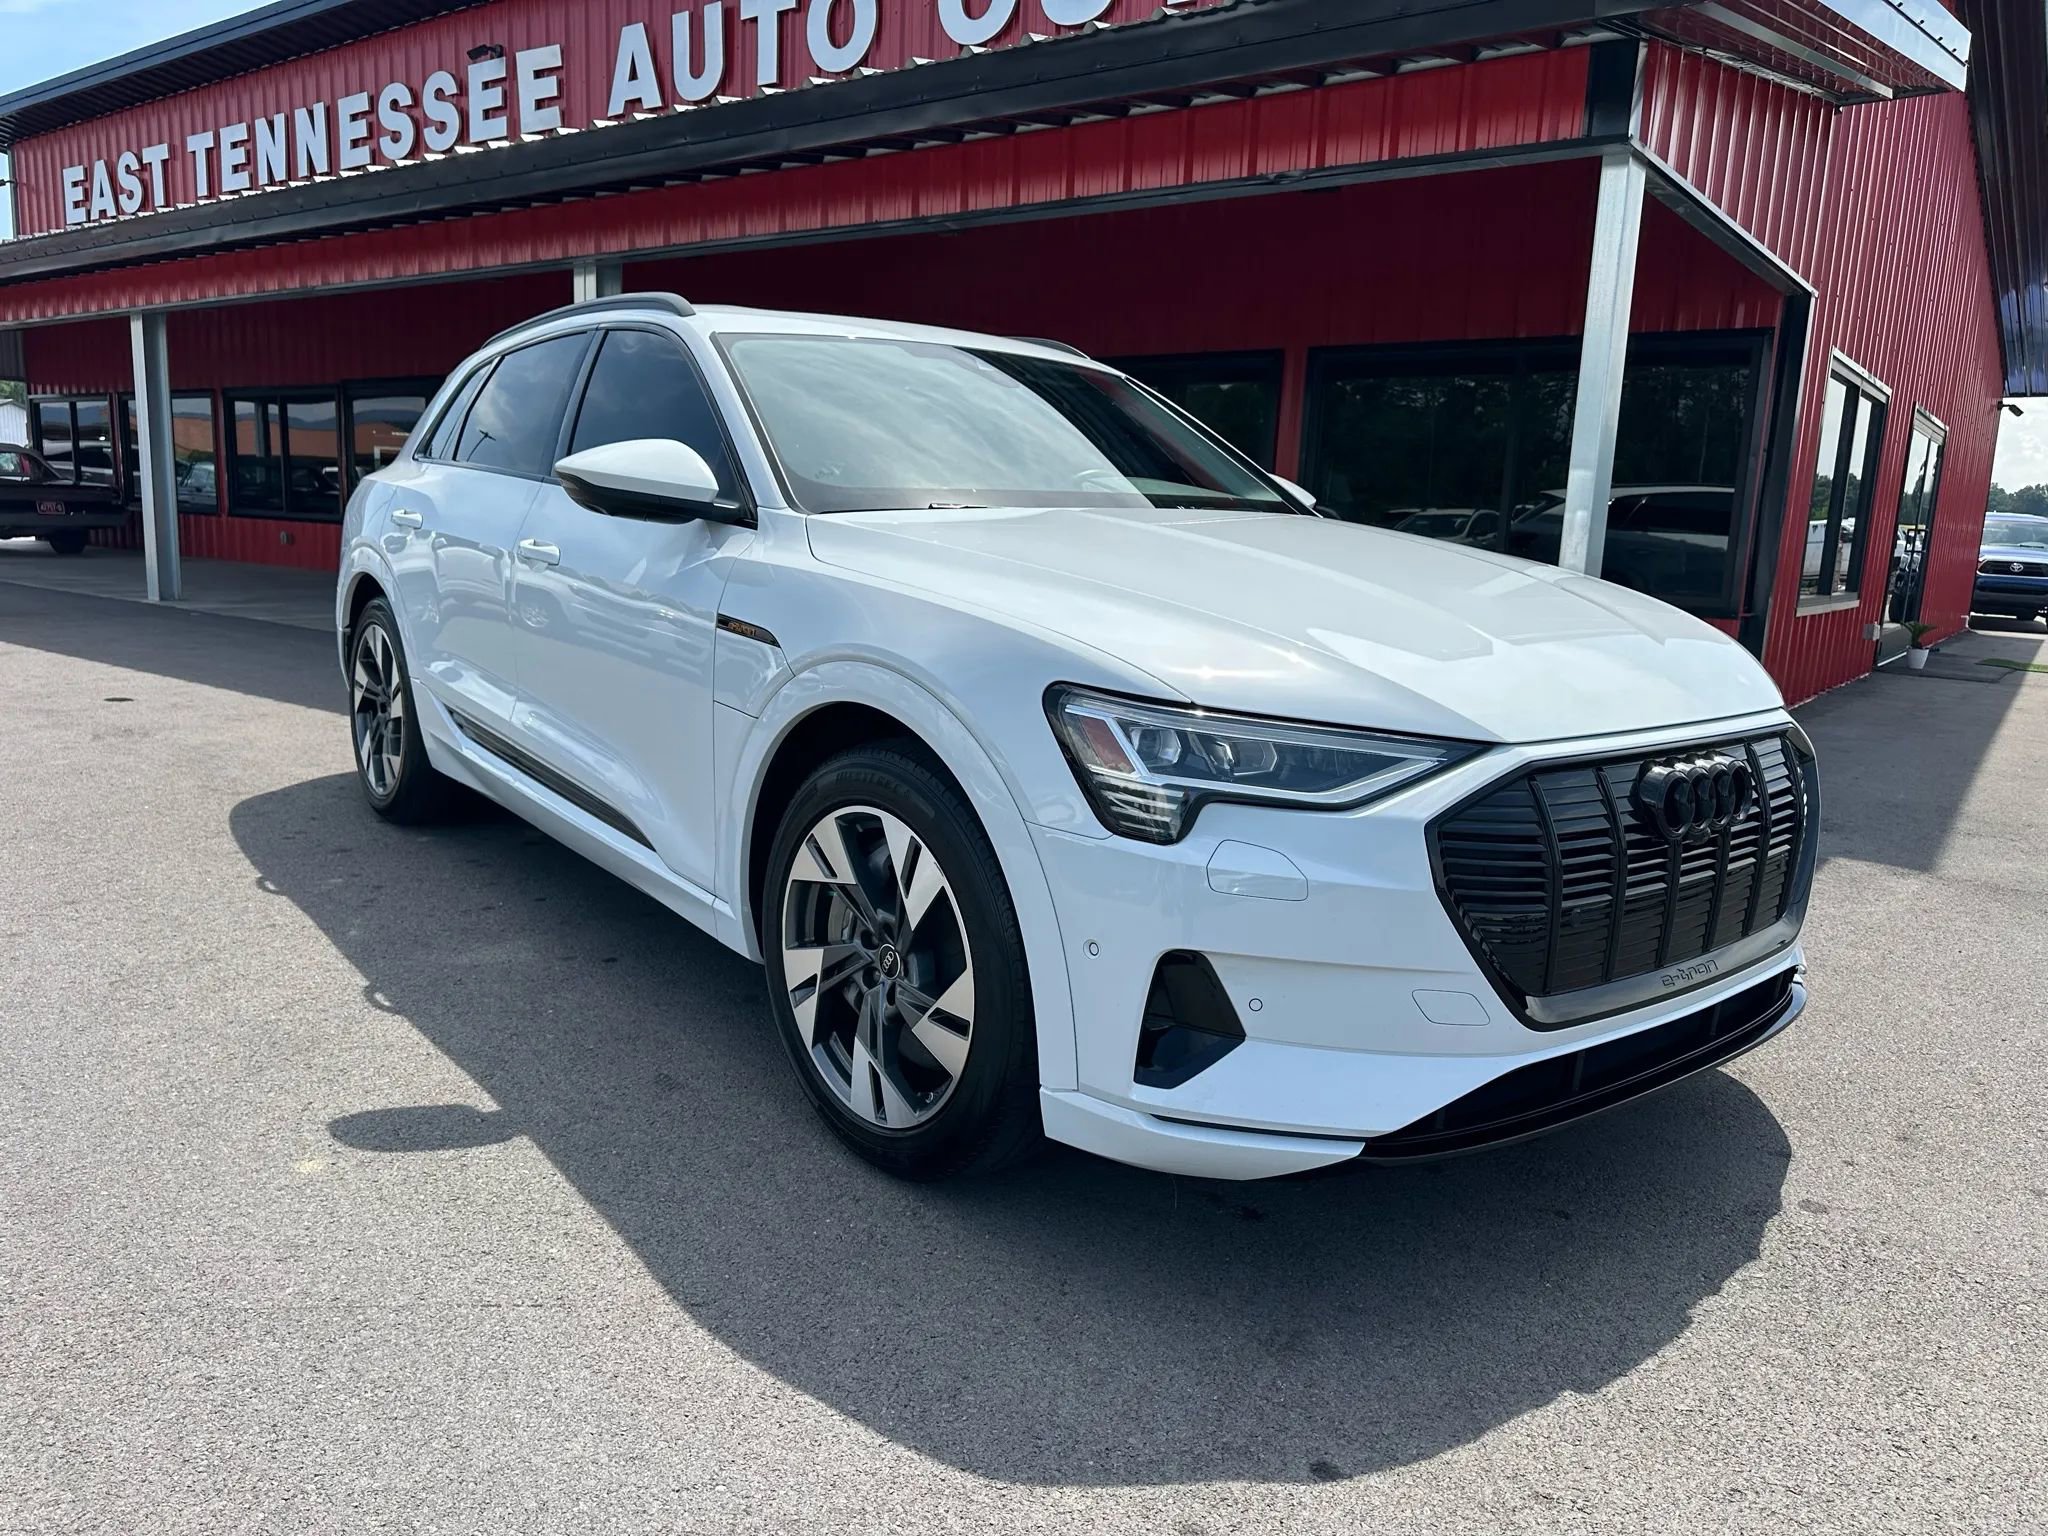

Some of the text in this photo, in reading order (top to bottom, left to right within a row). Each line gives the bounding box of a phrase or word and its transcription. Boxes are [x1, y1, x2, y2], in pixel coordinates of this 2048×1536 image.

[62, 0, 877, 225] EAST TENNESSEE AUTO
[1660, 958, 1719, 987] e-tron
